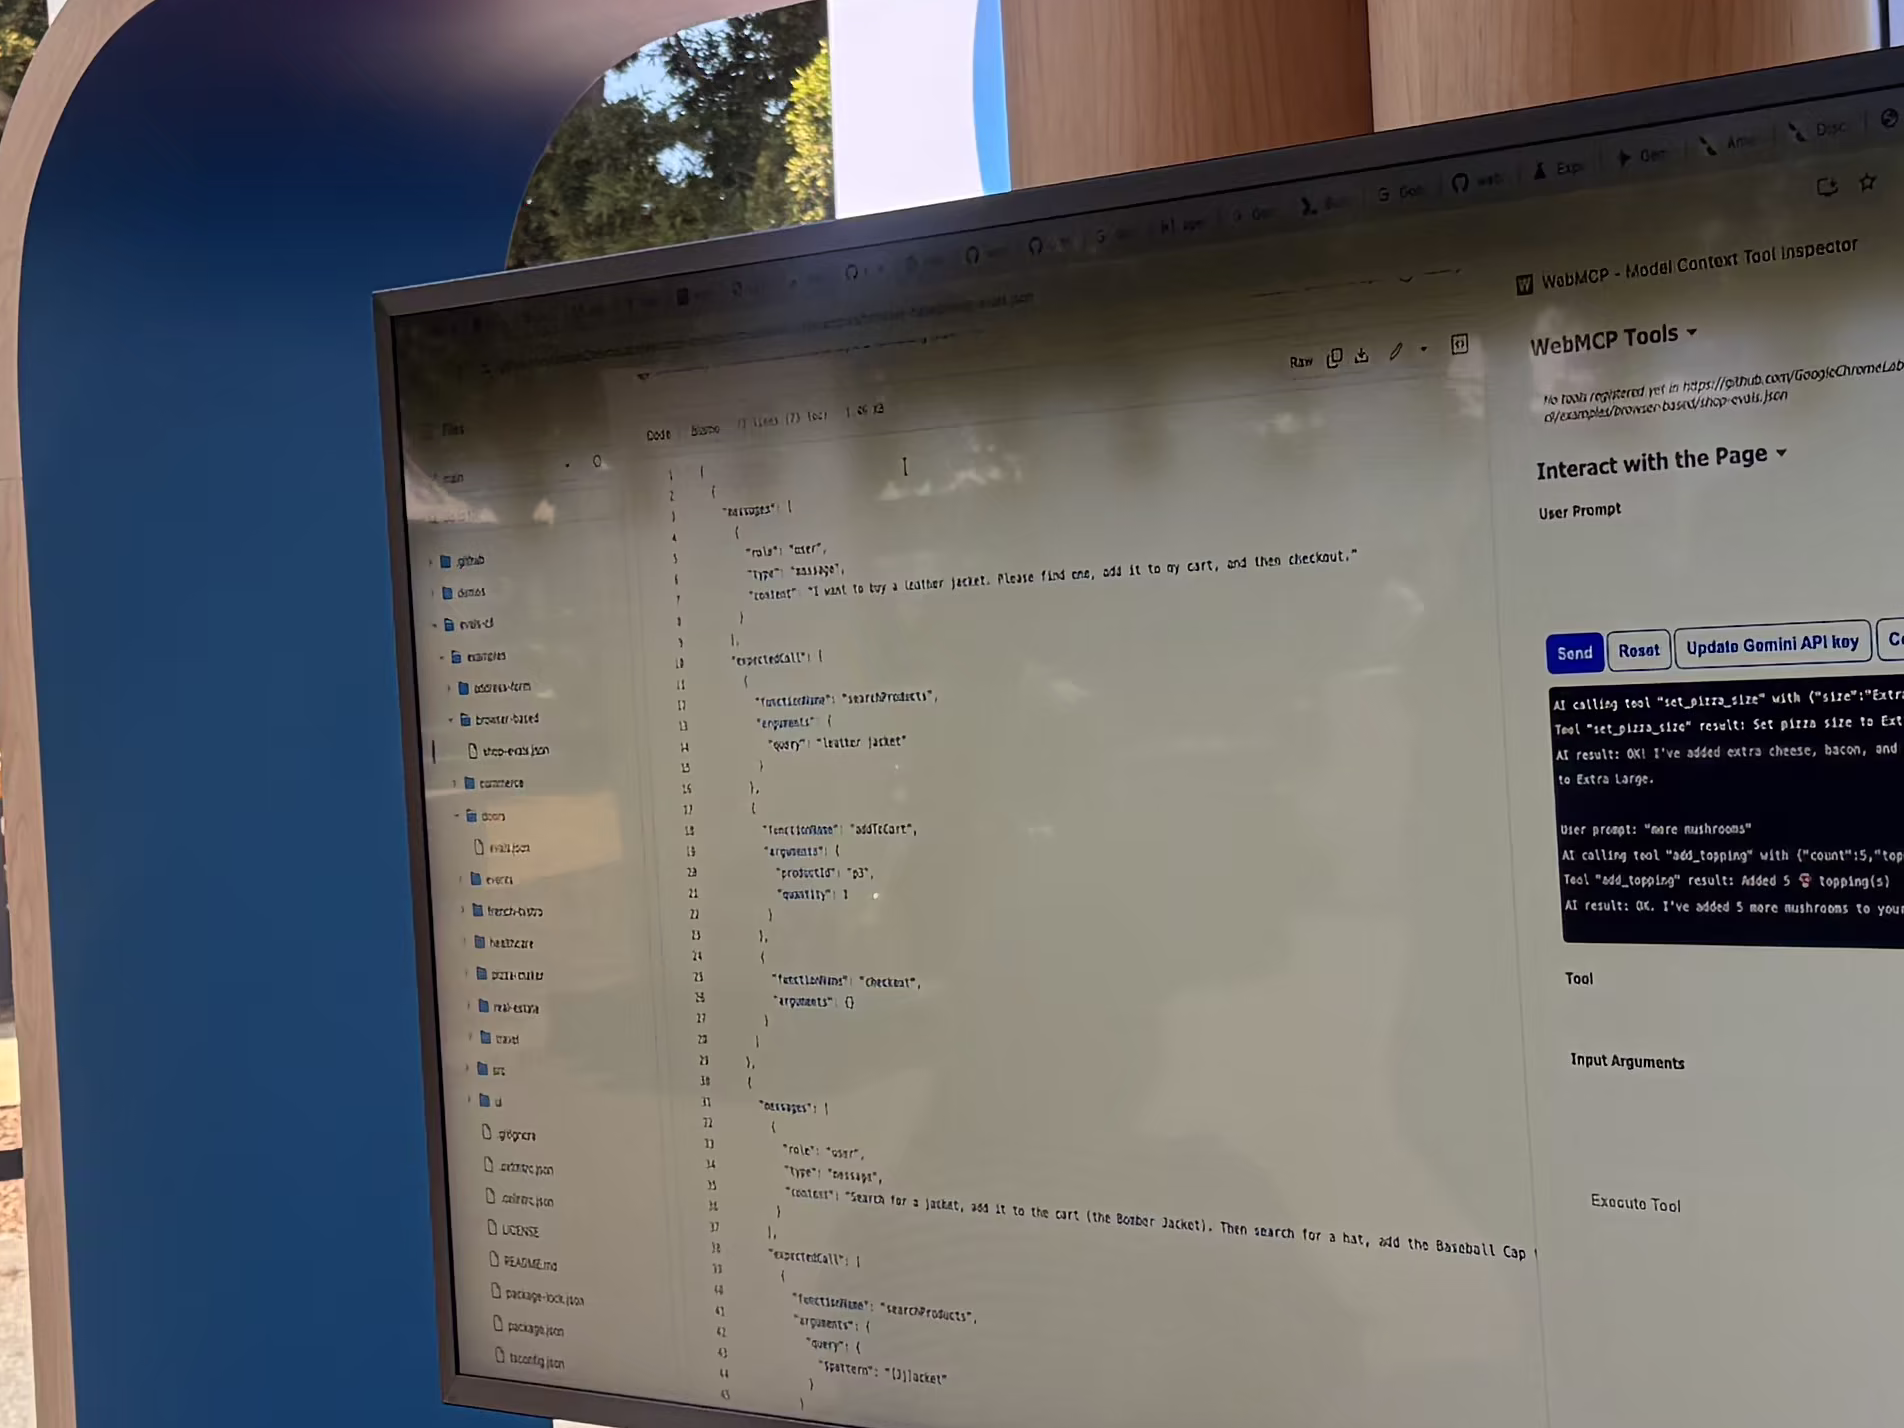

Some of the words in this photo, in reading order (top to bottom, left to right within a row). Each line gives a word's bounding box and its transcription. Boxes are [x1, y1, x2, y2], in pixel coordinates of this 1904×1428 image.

[1541, 267, 1610, 290] WebMCP
[1625, 258, 1673, 279] Model
[1676, 252, 1739, 273] Context
[1743, 245, 1777, 265] Tool
[1780, 238, 1859, 261] Inspector
[1529, 329, 1619, 357] WebMCP
[1623, 323, 1679, 347] Tools
[1536, 456, 1618, 481] Interact
[1622, 450, 1669, 474] with
[1674, 448, 1710, 469] the
[1715, 446, 1768, 468] Page
[1538, 507, 1569, 521] User
[1571, 501, 1622, 518] Prompt
[1557, 644, 1593, 661] Send
[1618, 643, 1661, 659] Reset
[1686, 639, 1739, 658] Update
[1742, 635, 1797, 653] Gemini
[1799, 634, 1828, 651] API
[1830, 634, 1860, 652] key
[1564, 970, 1594, 986] Tool
[1570, 1051, 1608, 1069] Input
[1610, 1053, 1686, 1071] Arguments
[1590, 1192, 1647, 1211] Execute
[1650, 1196, 1681, 1213] Tool
